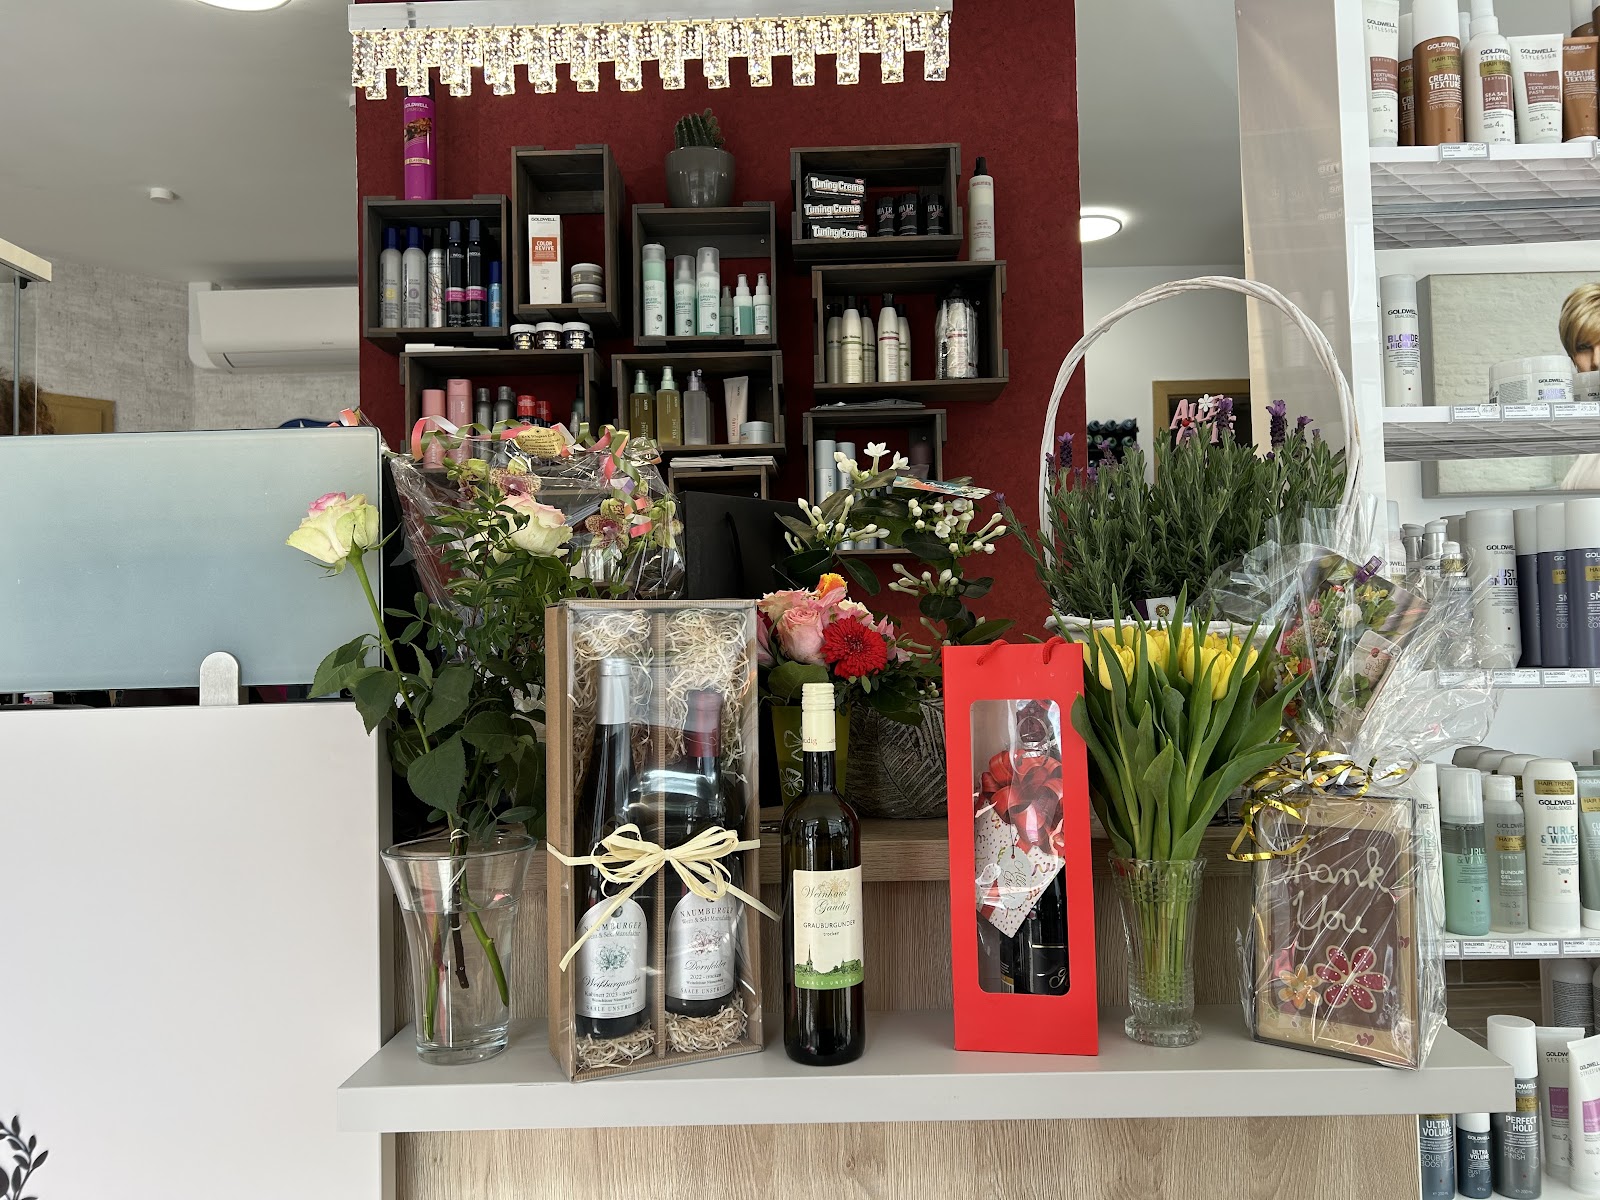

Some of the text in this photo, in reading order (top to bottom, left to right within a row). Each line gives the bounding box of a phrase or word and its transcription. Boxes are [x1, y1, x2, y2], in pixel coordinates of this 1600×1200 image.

[1367, 18, 1397, 28] GOLDWELL
[1367, 25, 1397, 34] STYLESIGN
[1427, 41, 1459, 50] GOLDWELL
[1564, 69, 1595, 77] CREATIVE
[1429, 73, 1461, 84] CREATIVE
[1430, 81, 1461, 90] TEXTURE
[810, 176, 865, 193] Tuning Creme
[803, 203, 862, 216] Tuning Creme
[899, 204, 914, 213] HAIR
[811, 224, 867, 239] Tuning Creme
[1496, 569, 1515, 577] JUST
[1547, 826, 1574, 835] CURLS
[1540, 834, 1578, 844] & WAVES
[1457, 856, 1463, 864] &
[801, 885, 847, 899] Weinhaus
[680, 906, 734, 917] NAUMBURGER
[814, 898, 851, 915] Gaudig
[803, 919, 856, 929] GRAUBURGUNDER
[1292, 890, 1368, 951] You
[684, 959, 727, 973] Dornfelder
[581, 974, 642, 991] Weißburgunder
[681, 984, 727, 995] SAALE UNSTRUT
[586, 1001, 636, 1012] SAALE UNSTRUT
[1426, 1119, 1450, 1129] ULTRA
[1505, 1114, 1537, 1125] PERFECT
[1422, 1127, 1452, 1137] VOLUME
[1512, 1124, 1529, 1133] HOLD
[1503, 1145, 1526, 1155] MAGIC
[1503, 1152, 1526, 1161] FINISH
